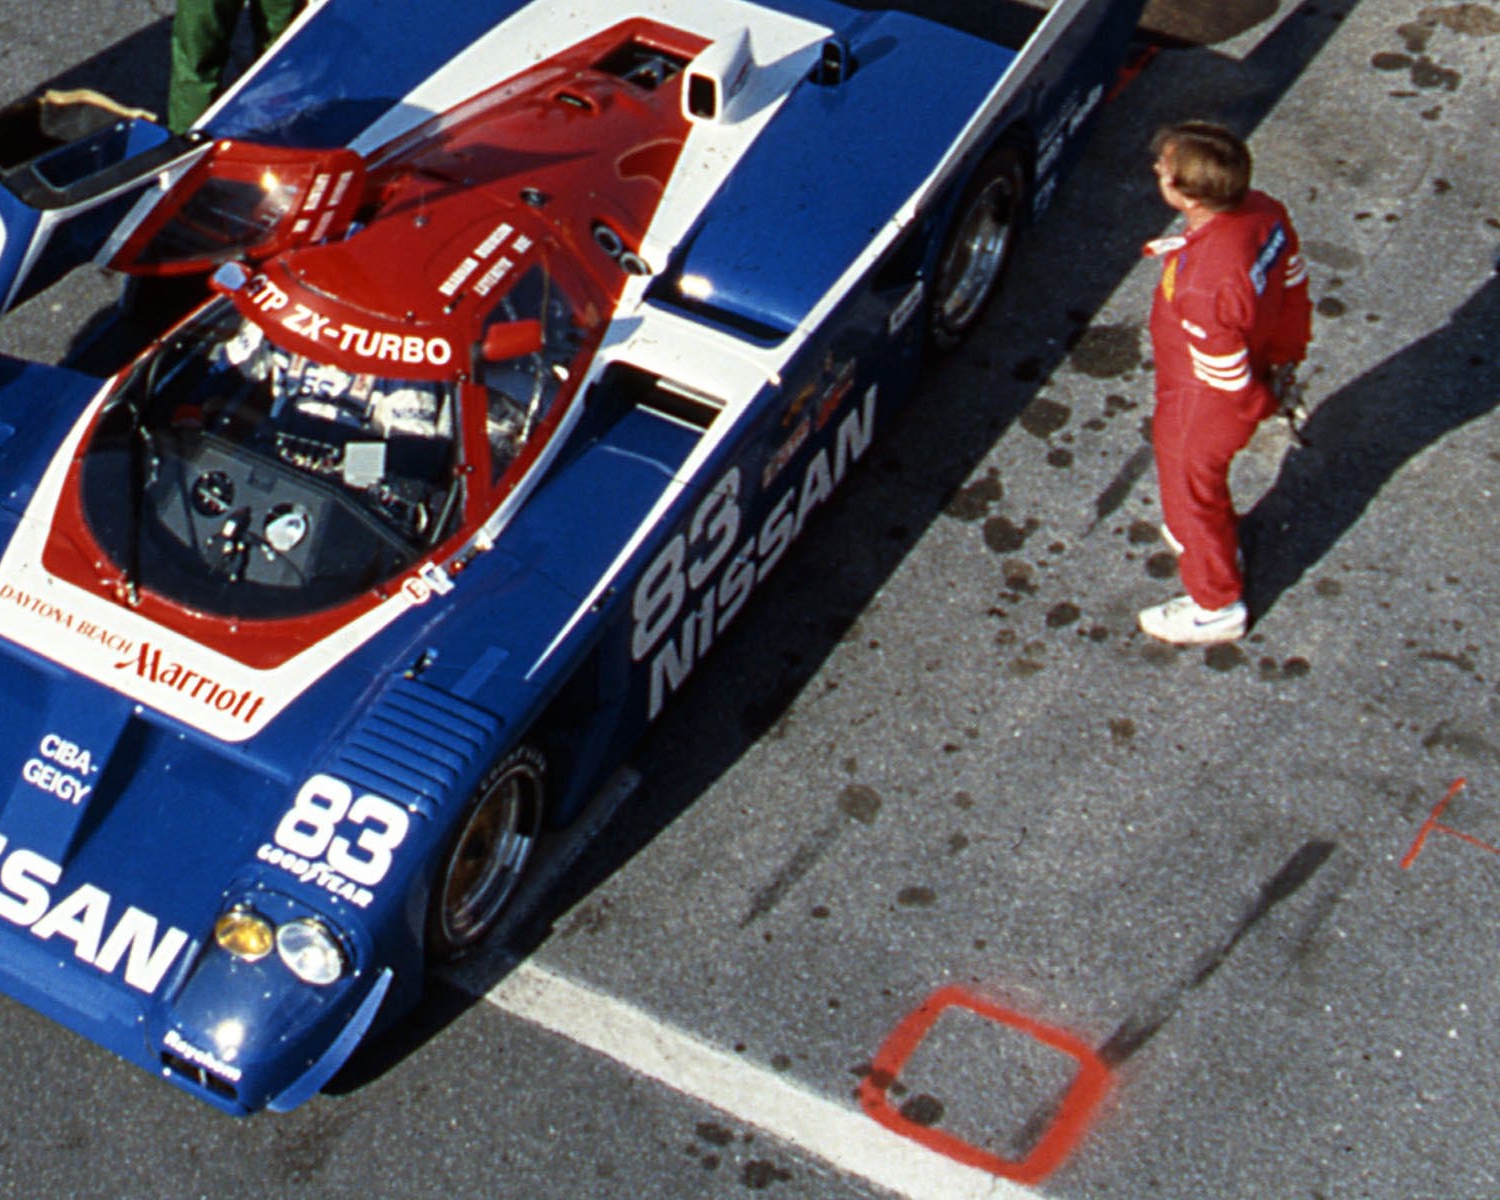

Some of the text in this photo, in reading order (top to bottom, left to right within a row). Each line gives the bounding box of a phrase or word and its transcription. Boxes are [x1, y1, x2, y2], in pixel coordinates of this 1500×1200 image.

[249, 273, 452, 366] GTP ZX-TURBO
[632, 465, 741, 662] 83
[648, 382, 879, 722] NISSAN
[76, 618, 133, 655] BEACH
[114, 642, 265, 724] Marriott
[22, 757, 91, 805] GEIGY
[39, 734, 98, 774] CIBA-
[257, 843, 374, 909] GOODYEAR
[274, 773, 410, 886] 83
